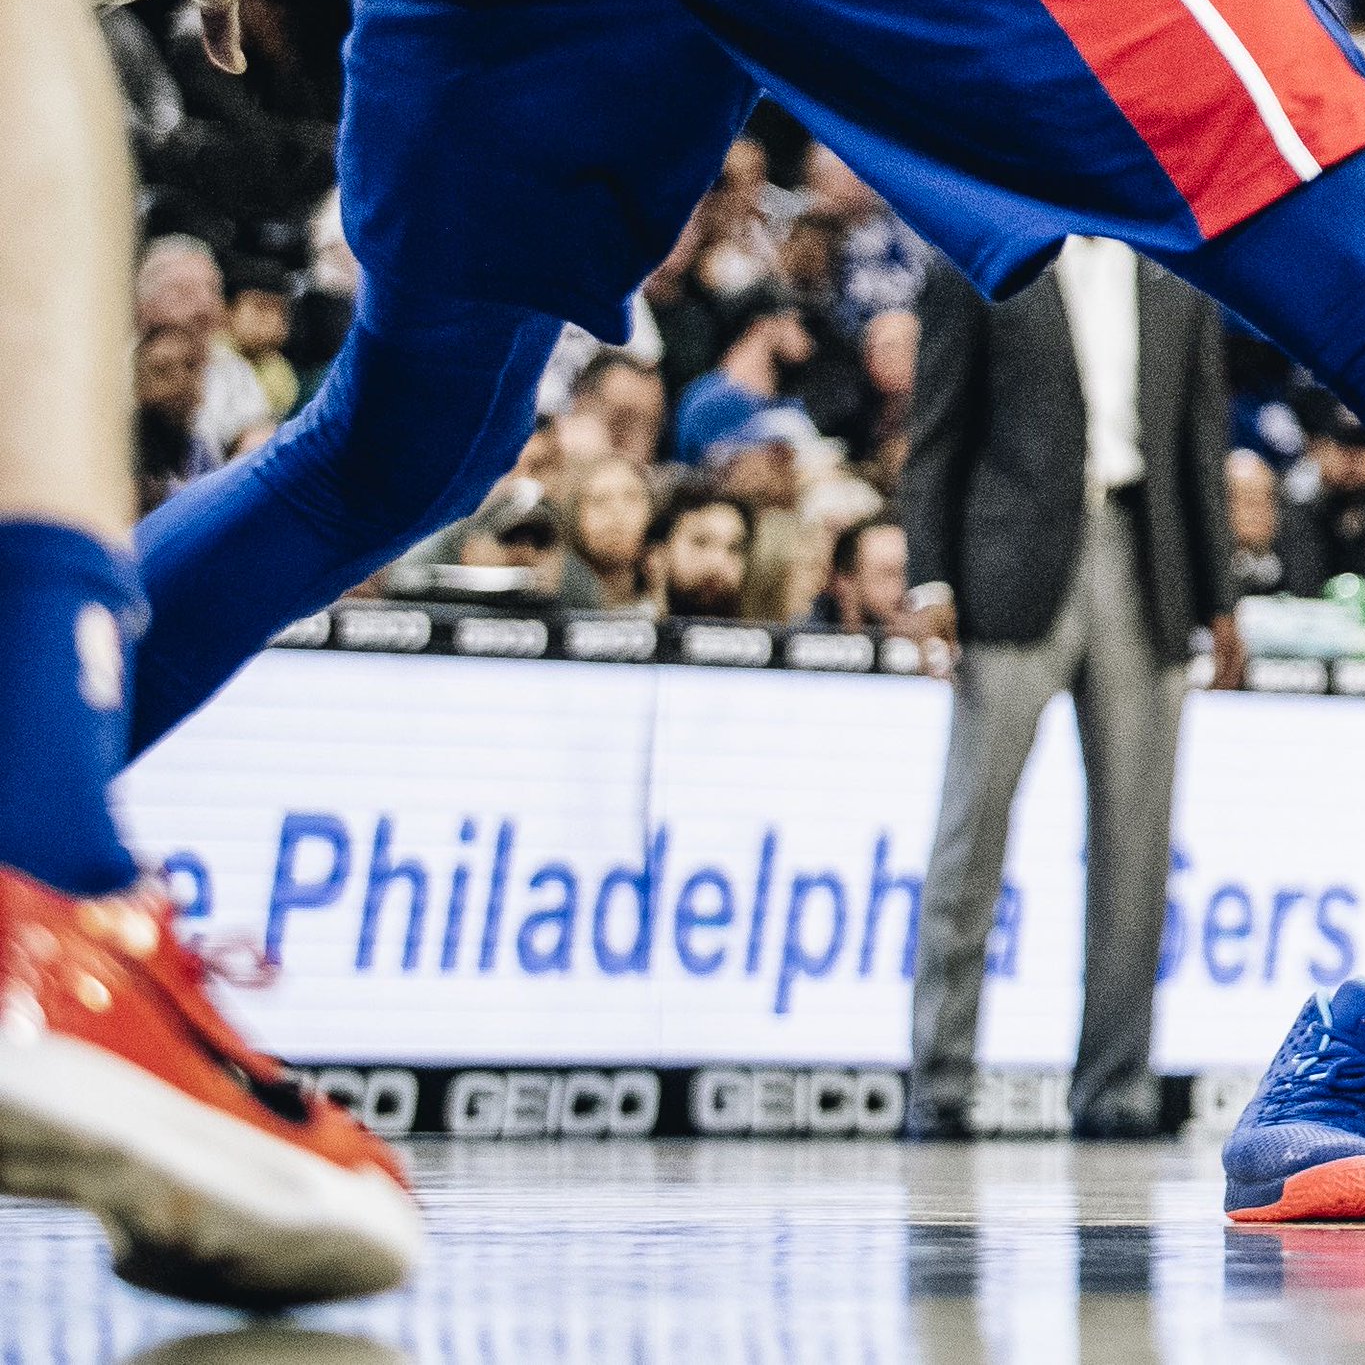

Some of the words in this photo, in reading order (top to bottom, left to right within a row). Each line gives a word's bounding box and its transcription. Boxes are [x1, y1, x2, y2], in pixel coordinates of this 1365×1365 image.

[264, 810, 1023, 1017] Philadelpha
[447, 1070, 661, 1134] GEICO
[690, 1071, 903, 1134] GEICO
